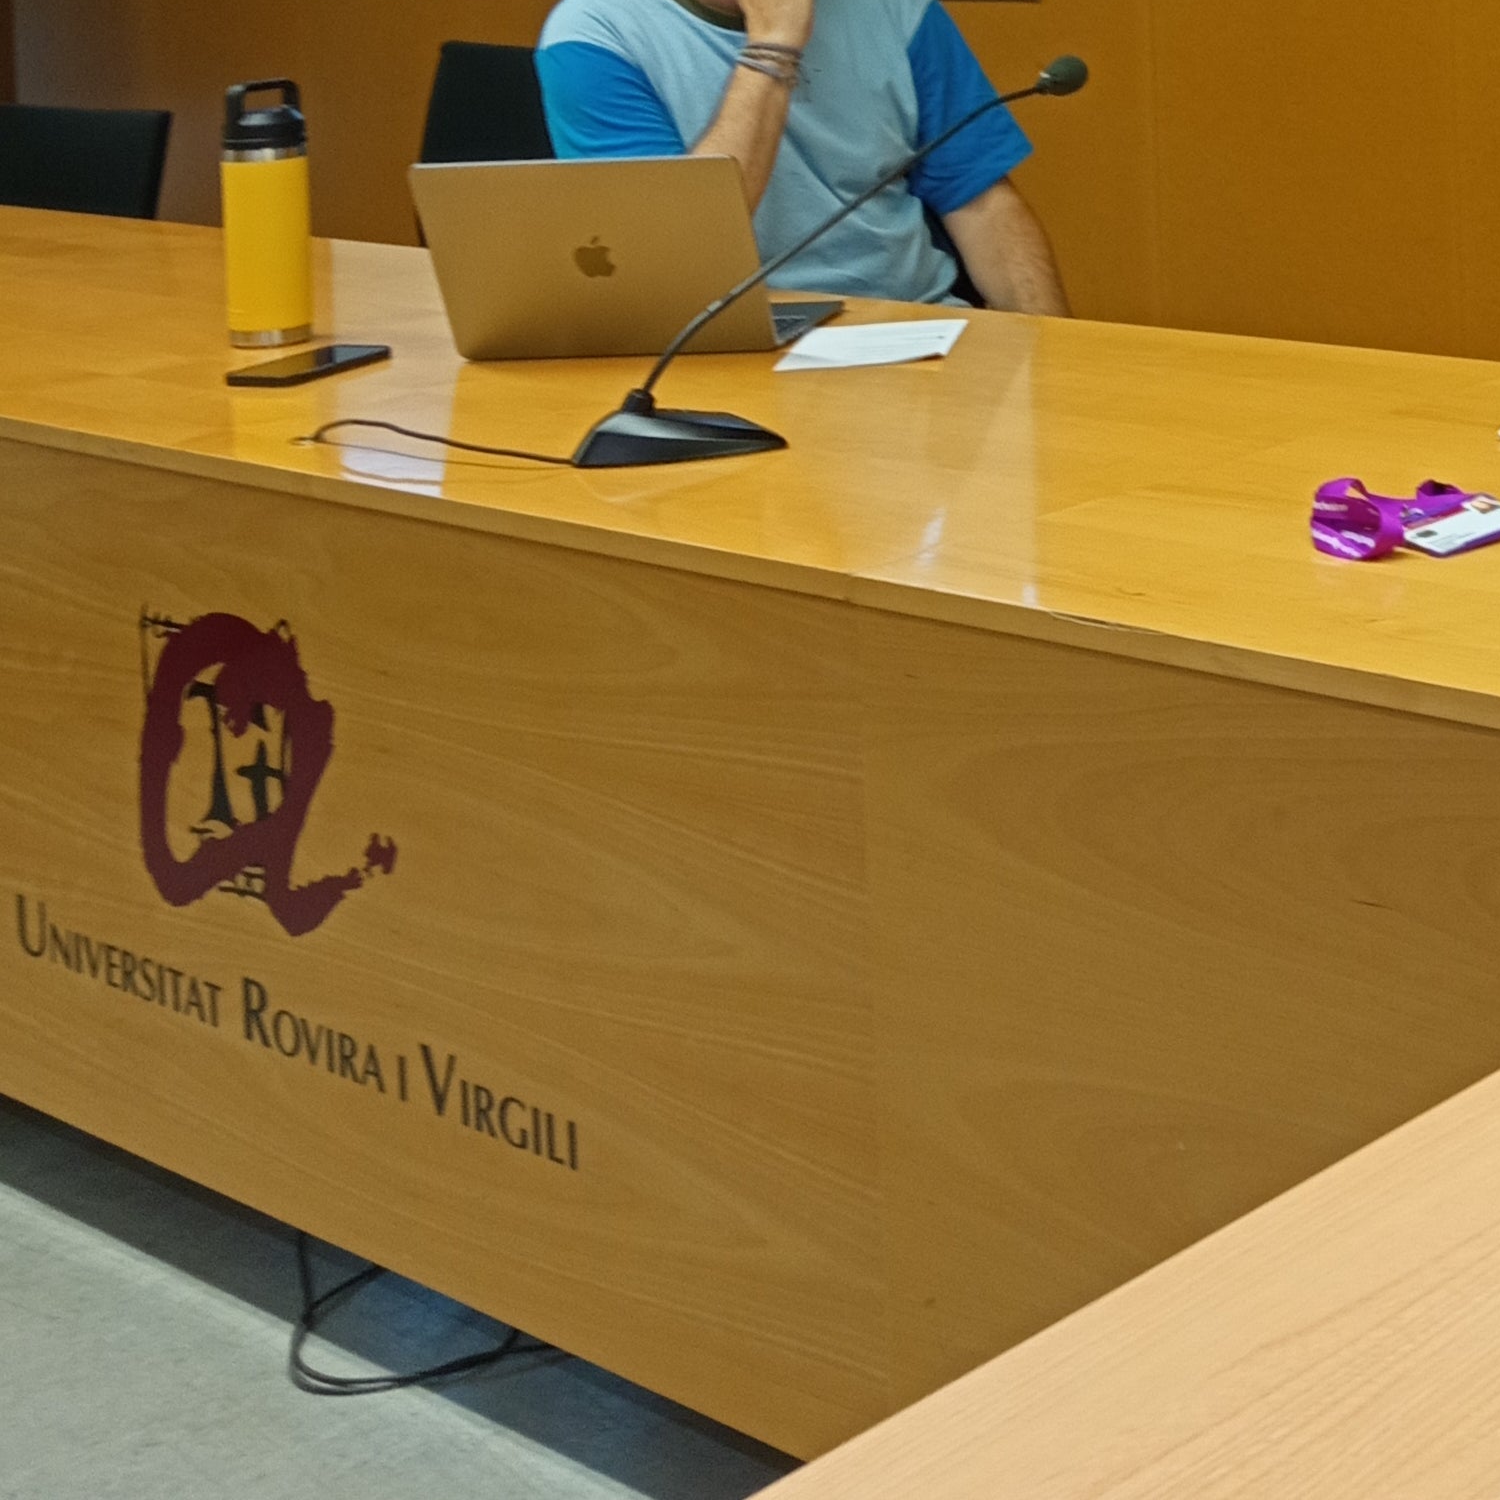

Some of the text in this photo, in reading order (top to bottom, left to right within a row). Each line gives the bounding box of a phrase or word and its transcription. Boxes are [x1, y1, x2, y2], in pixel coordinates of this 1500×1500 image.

[16, 894, 222, 1028] UNIVERSITAT
[241, 977, 386, 1094] ROVIRA
[420, 1044, 579, 1171] VIRGILI
